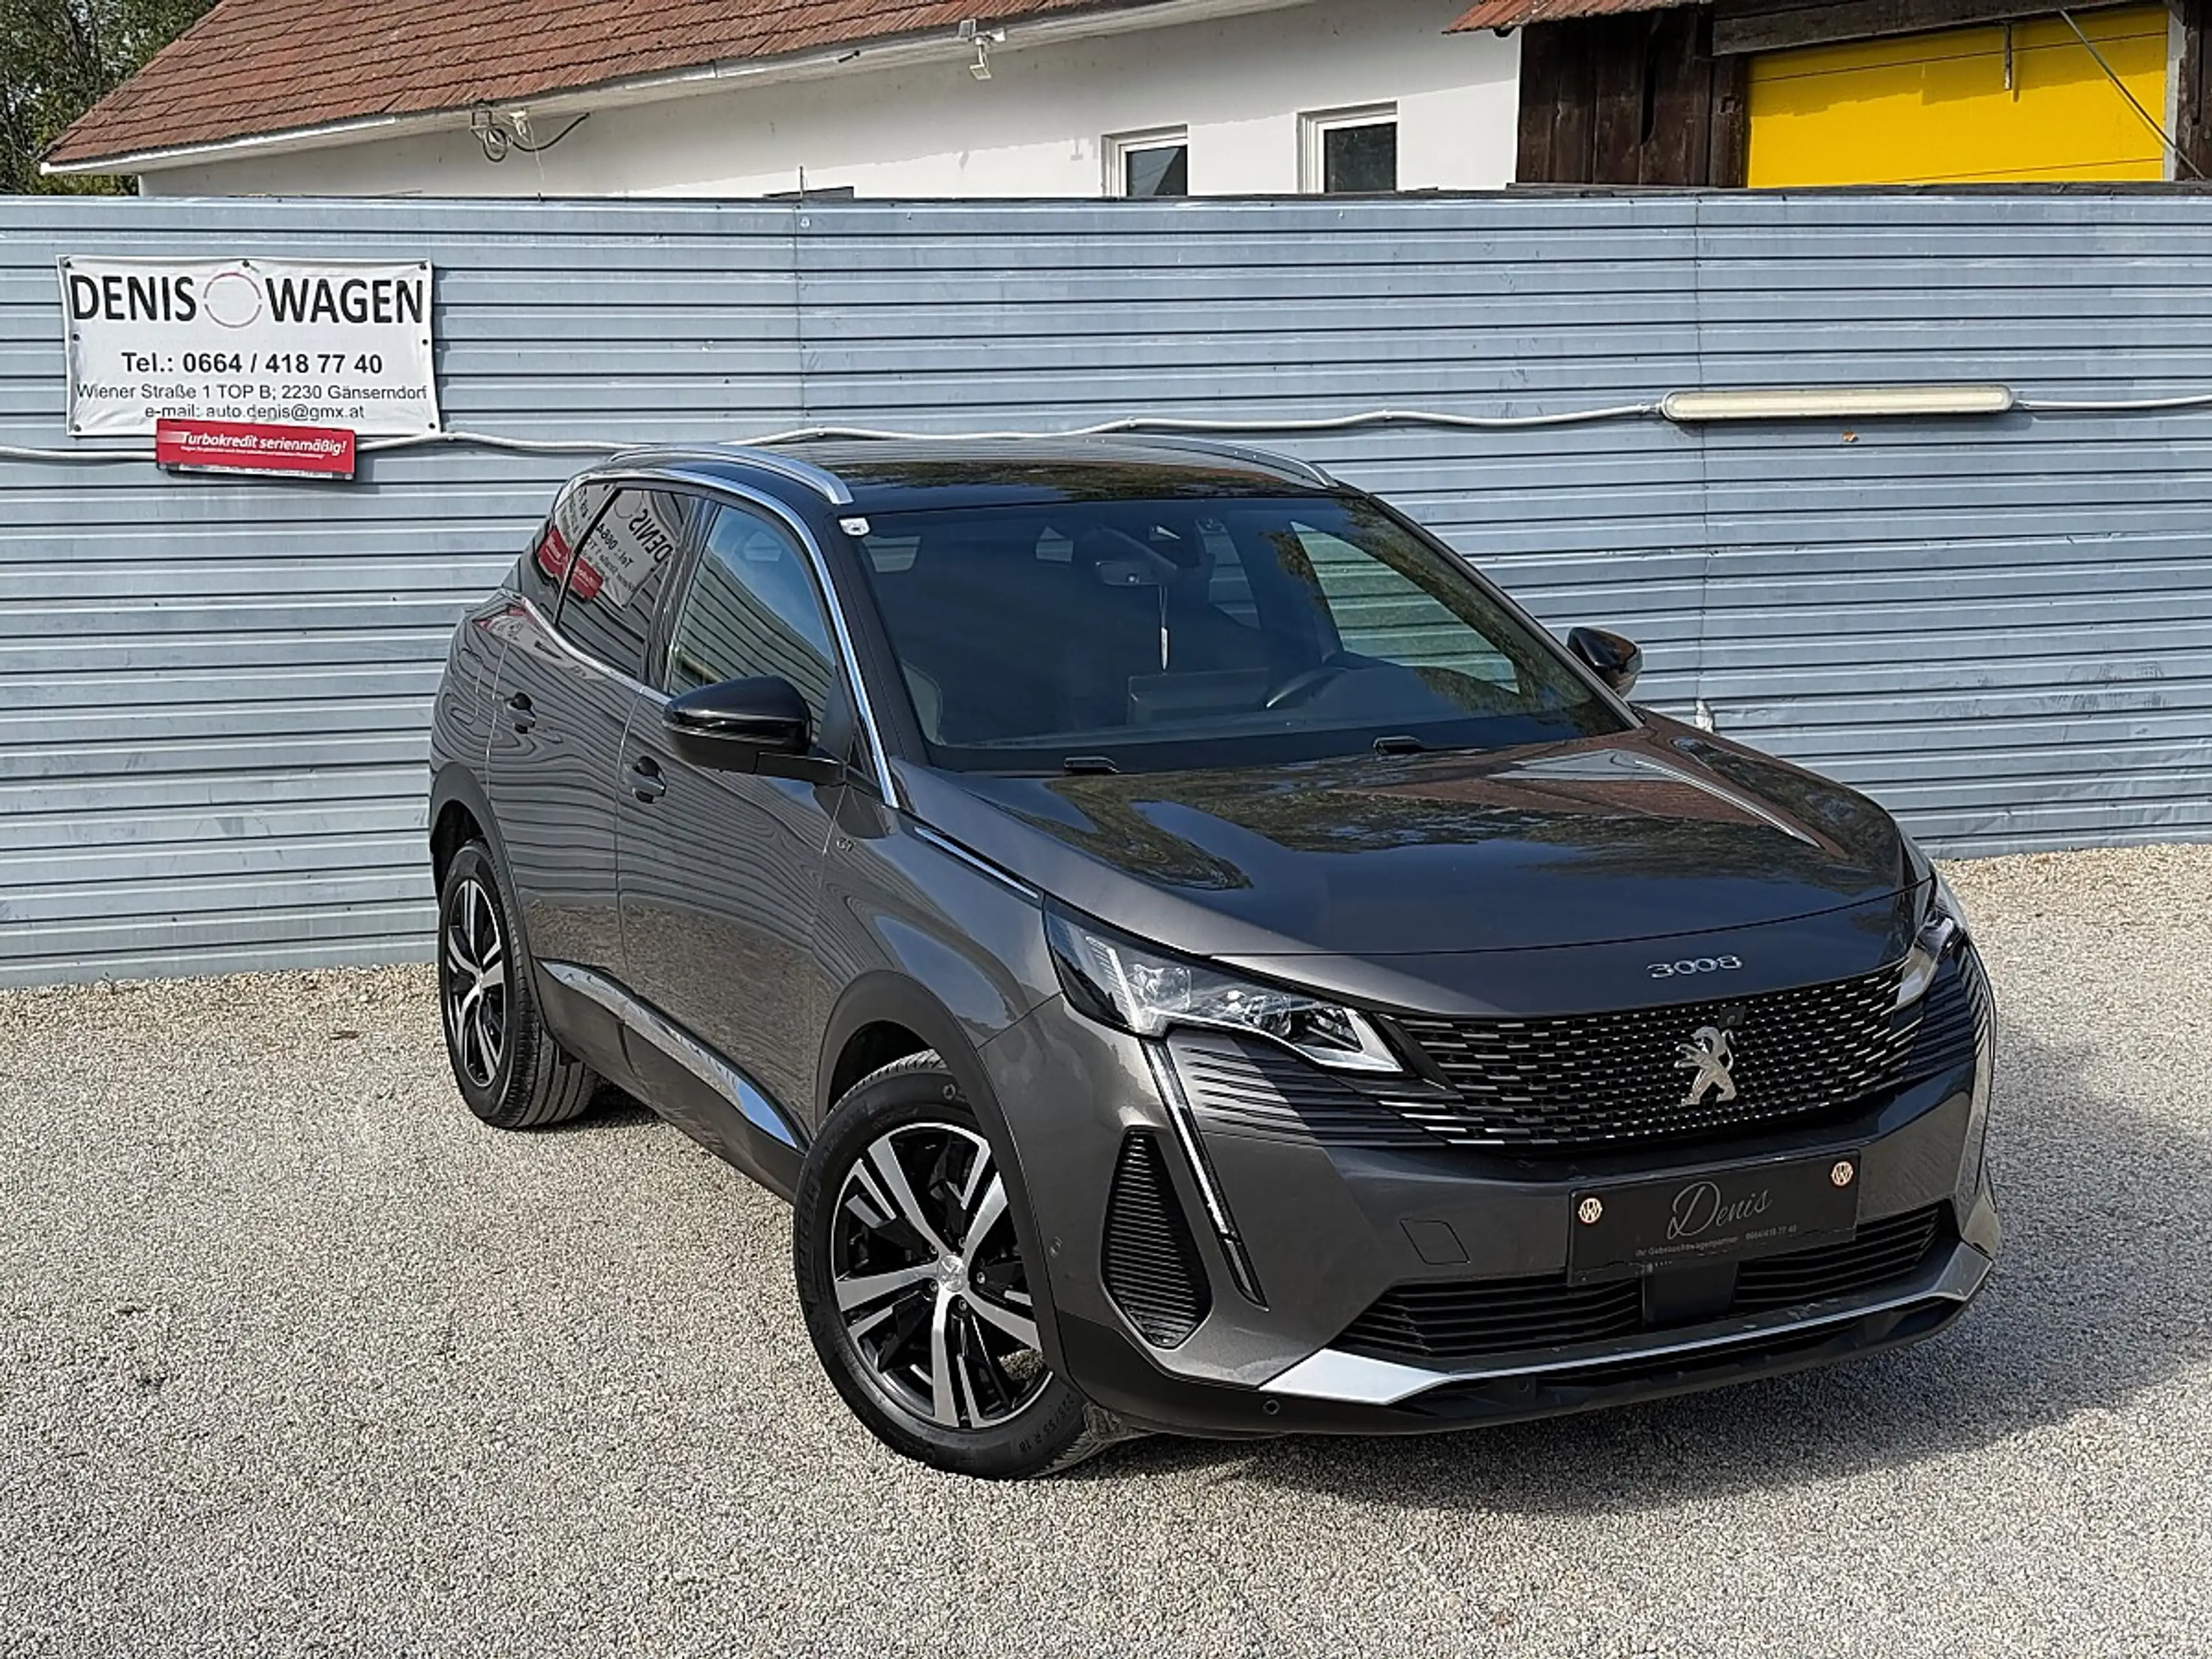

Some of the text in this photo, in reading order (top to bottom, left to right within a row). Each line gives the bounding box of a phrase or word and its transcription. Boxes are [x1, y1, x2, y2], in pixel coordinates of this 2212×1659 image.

[70, 275, 423, 324] DENIS WAGEN
[121, 352, 382, 373] Tel.: 0664 / 418 77 40
[76, 383, 427, 400] Wiener Straße 1 TOP B; 2230 Gänserndorf
[145, 404, 365, 421] e-mail: auto.denis@gmx.at
[183, 431, 259, 449] Turbokredit
[260, 437, 347, 456] serienmäßig!
[1646, 955, 1743, 978] 3008
[1666, 1181, 1773, 1240] Denis
